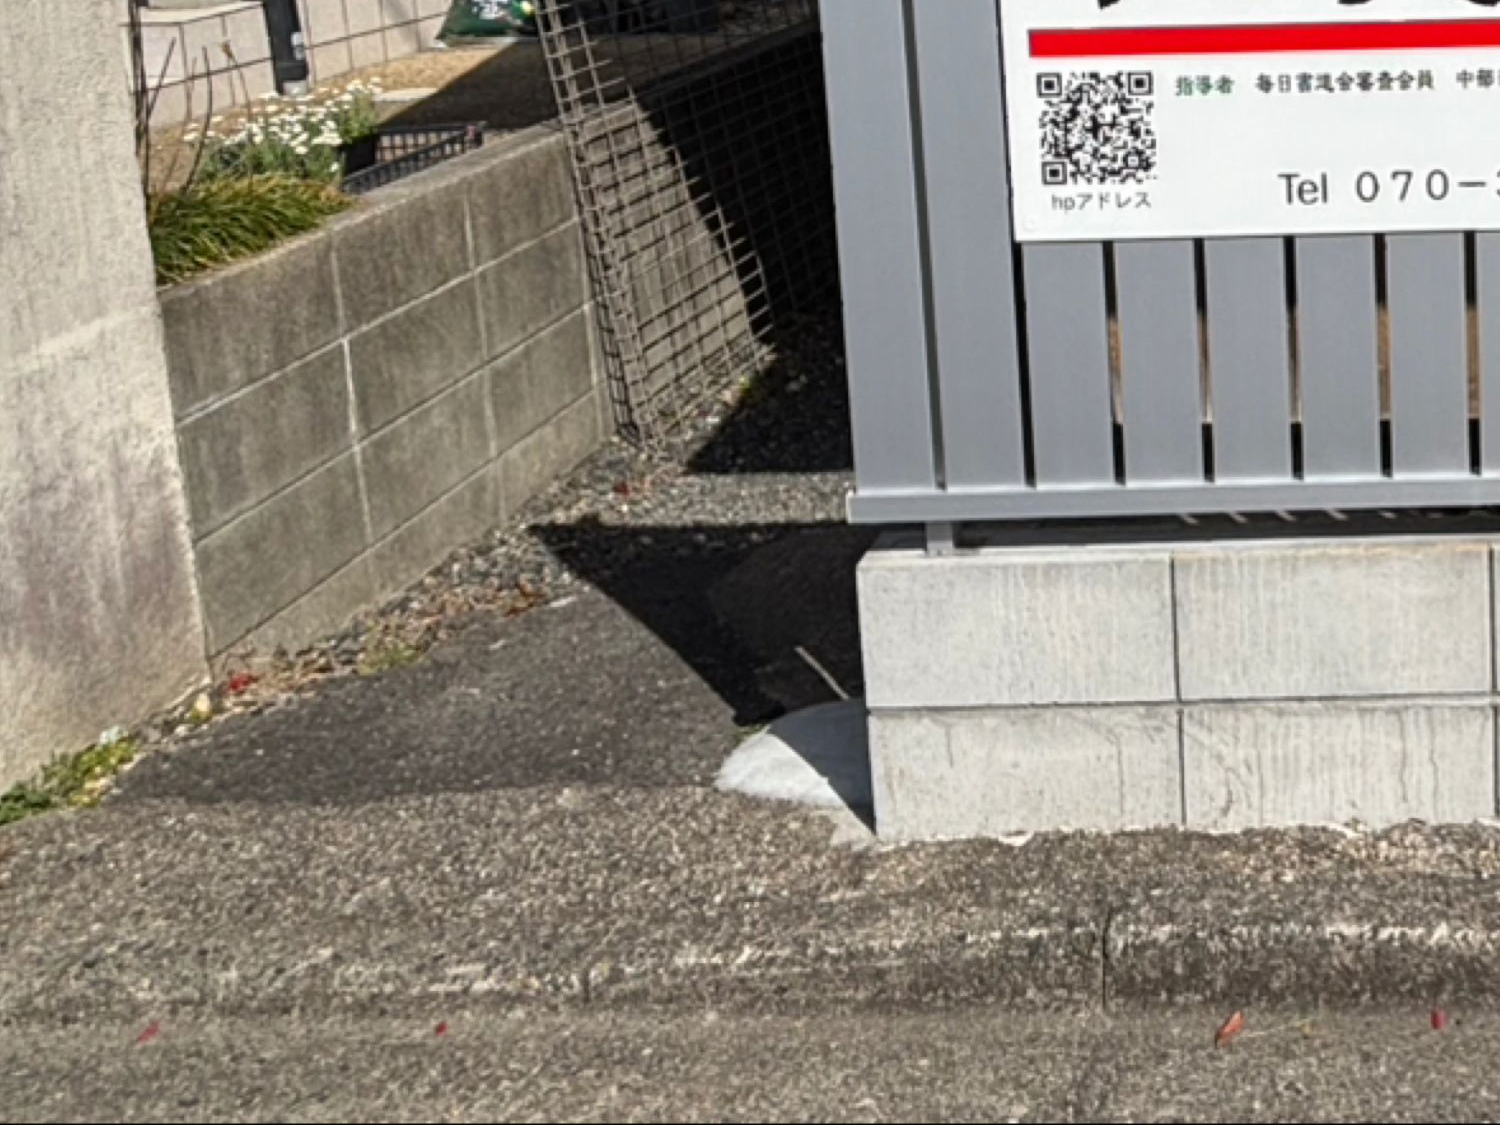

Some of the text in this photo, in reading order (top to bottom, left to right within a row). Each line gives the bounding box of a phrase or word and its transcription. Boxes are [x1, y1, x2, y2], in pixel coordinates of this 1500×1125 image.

[1174, 74, 1235, 96] 指導者
[1277, 171, 1329, 206] Tel
[1050, 191, 1152, 211] hpアドレス
